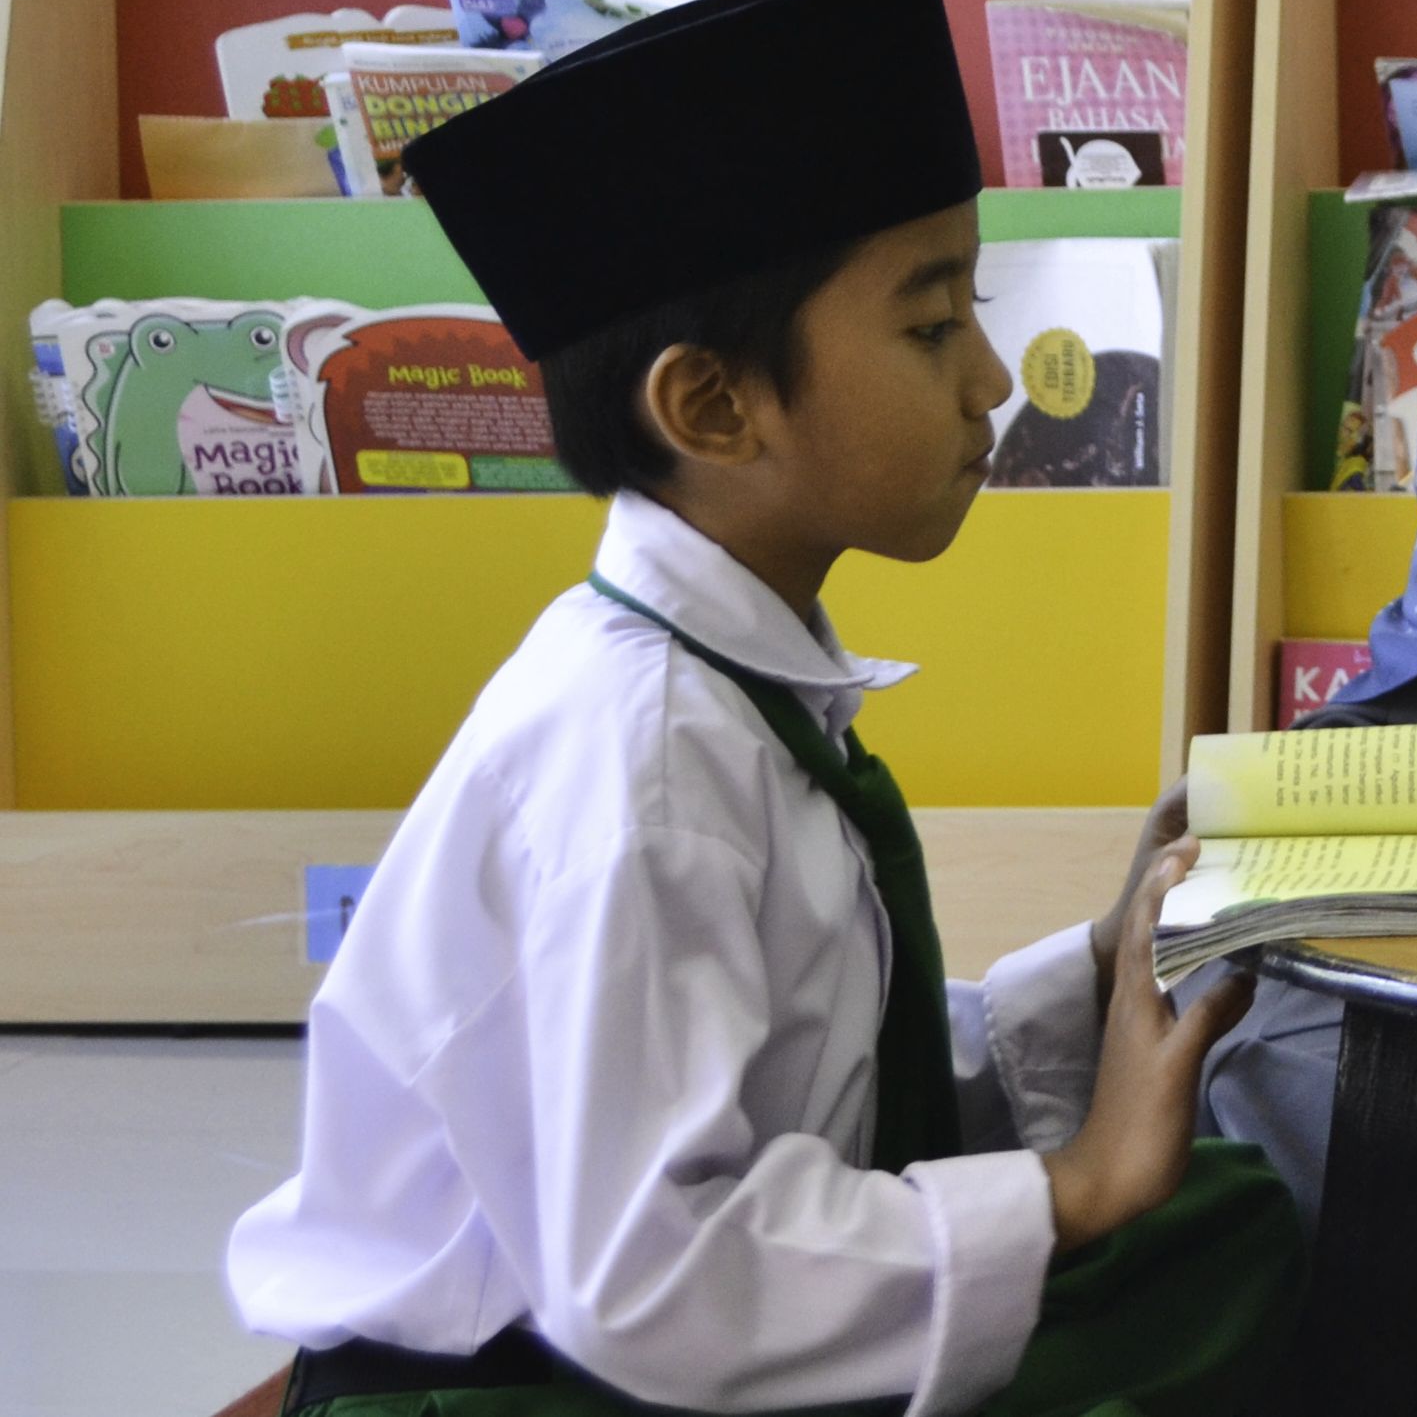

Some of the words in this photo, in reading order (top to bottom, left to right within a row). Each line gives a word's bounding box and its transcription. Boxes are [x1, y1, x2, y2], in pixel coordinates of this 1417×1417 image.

[357, 74, 489, 93] KUMPULAN
[1020, 55, 1181, 107] EJAAN
[1048, 107, 1170, 132] BAHASA
[388, 365, 460, 389] Magic
[468, 364, 527, 388] Book
